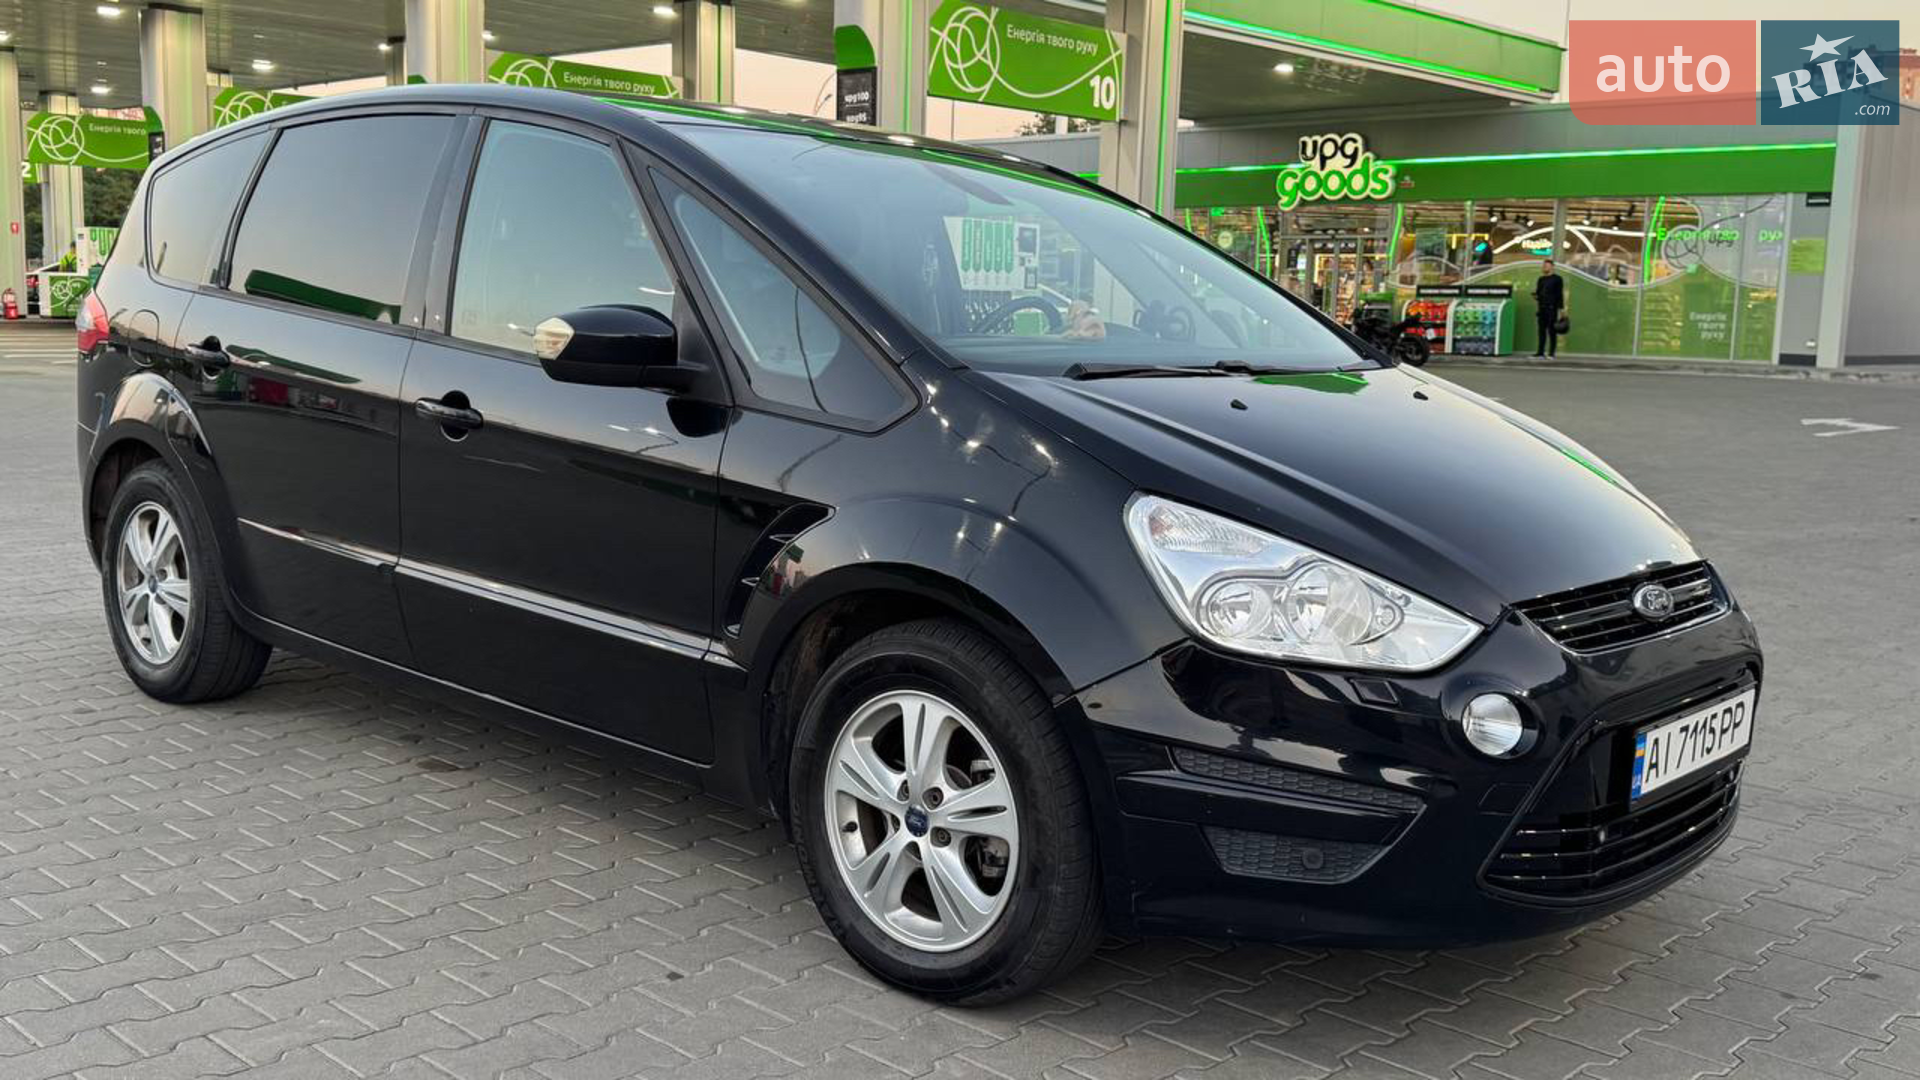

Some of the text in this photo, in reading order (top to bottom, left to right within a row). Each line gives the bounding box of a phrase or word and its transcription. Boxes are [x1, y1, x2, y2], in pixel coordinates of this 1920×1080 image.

[1006, 24, 1099, 57] Енергія твого руху
[563, 72, 655, 95] Енергія твого руху
[1090, 75, 1116, 110] 10
[1301, 136, 1360, 171] upg
[1277, 156, 1391, 209] goods
[1645, 700, 1746, 783] AI 7115 PP
